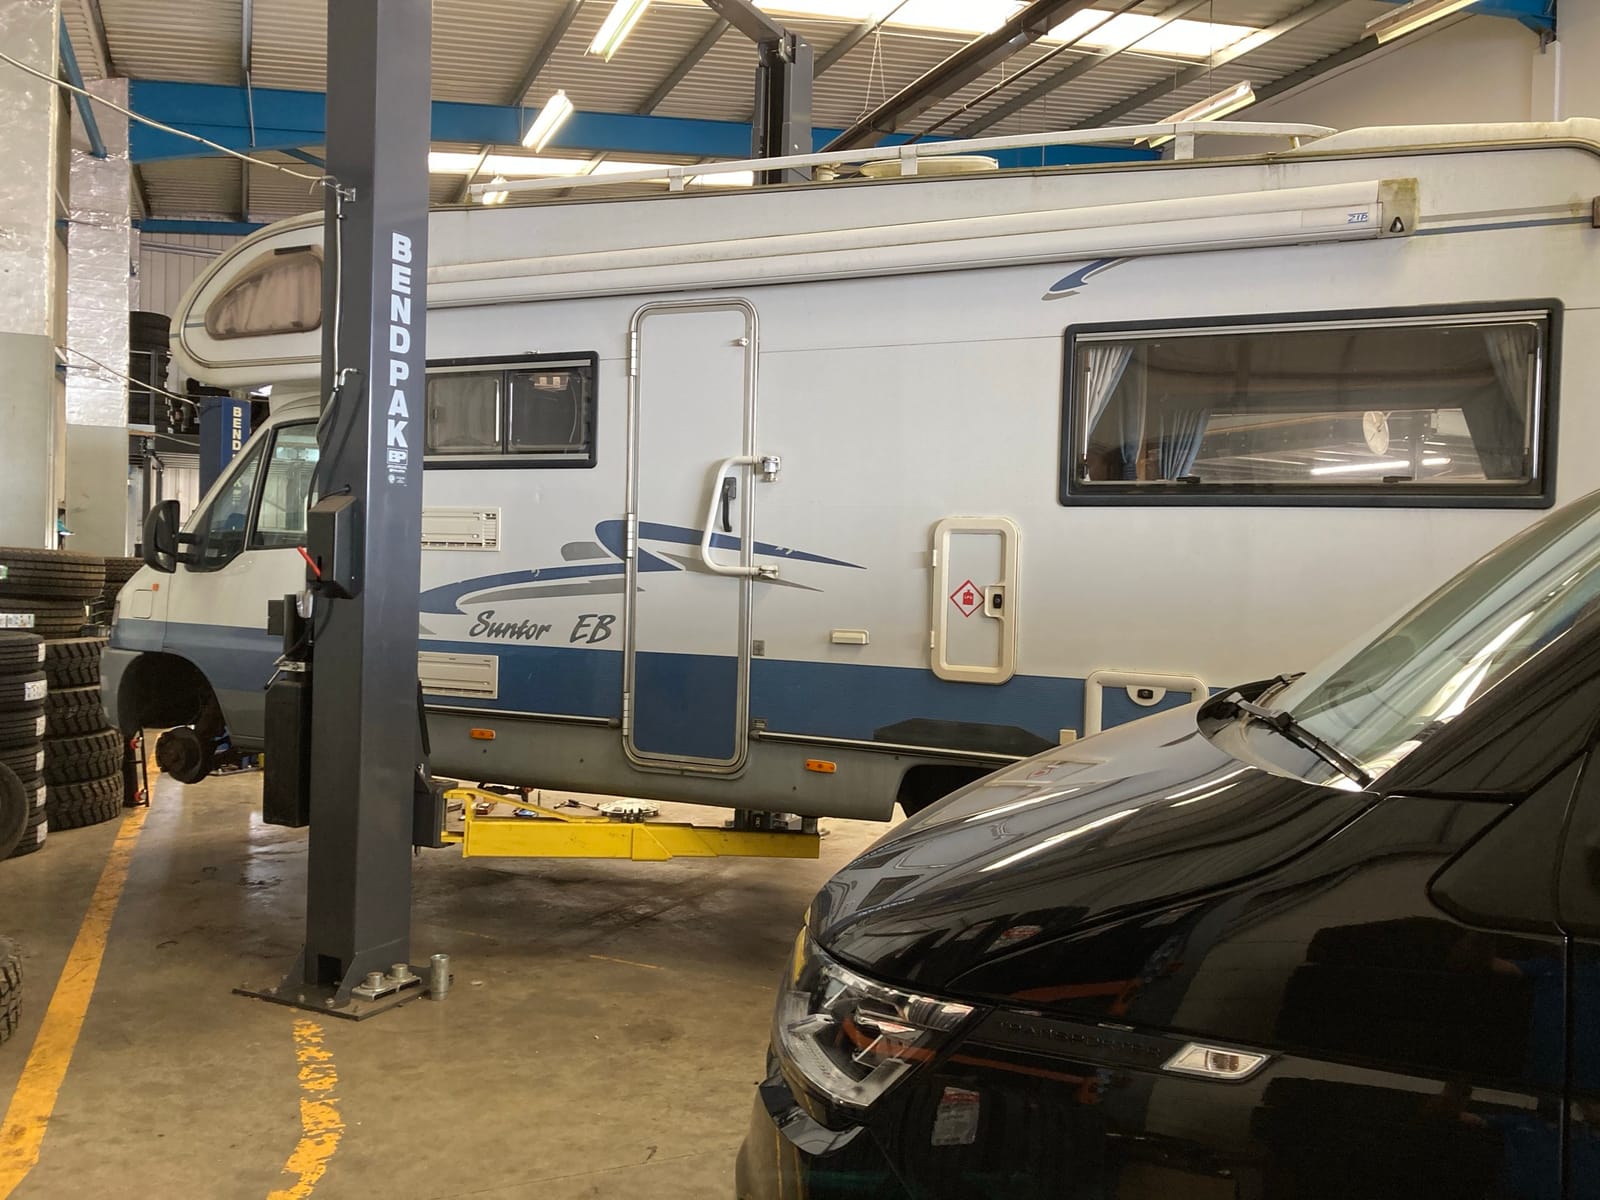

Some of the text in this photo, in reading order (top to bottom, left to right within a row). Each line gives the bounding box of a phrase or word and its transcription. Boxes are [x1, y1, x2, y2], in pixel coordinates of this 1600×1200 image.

[387, 232, 412, 448] BENDPAK
[232, 406, 242, 458] BEND
[469, 610, 616, 644] Suntor EB
